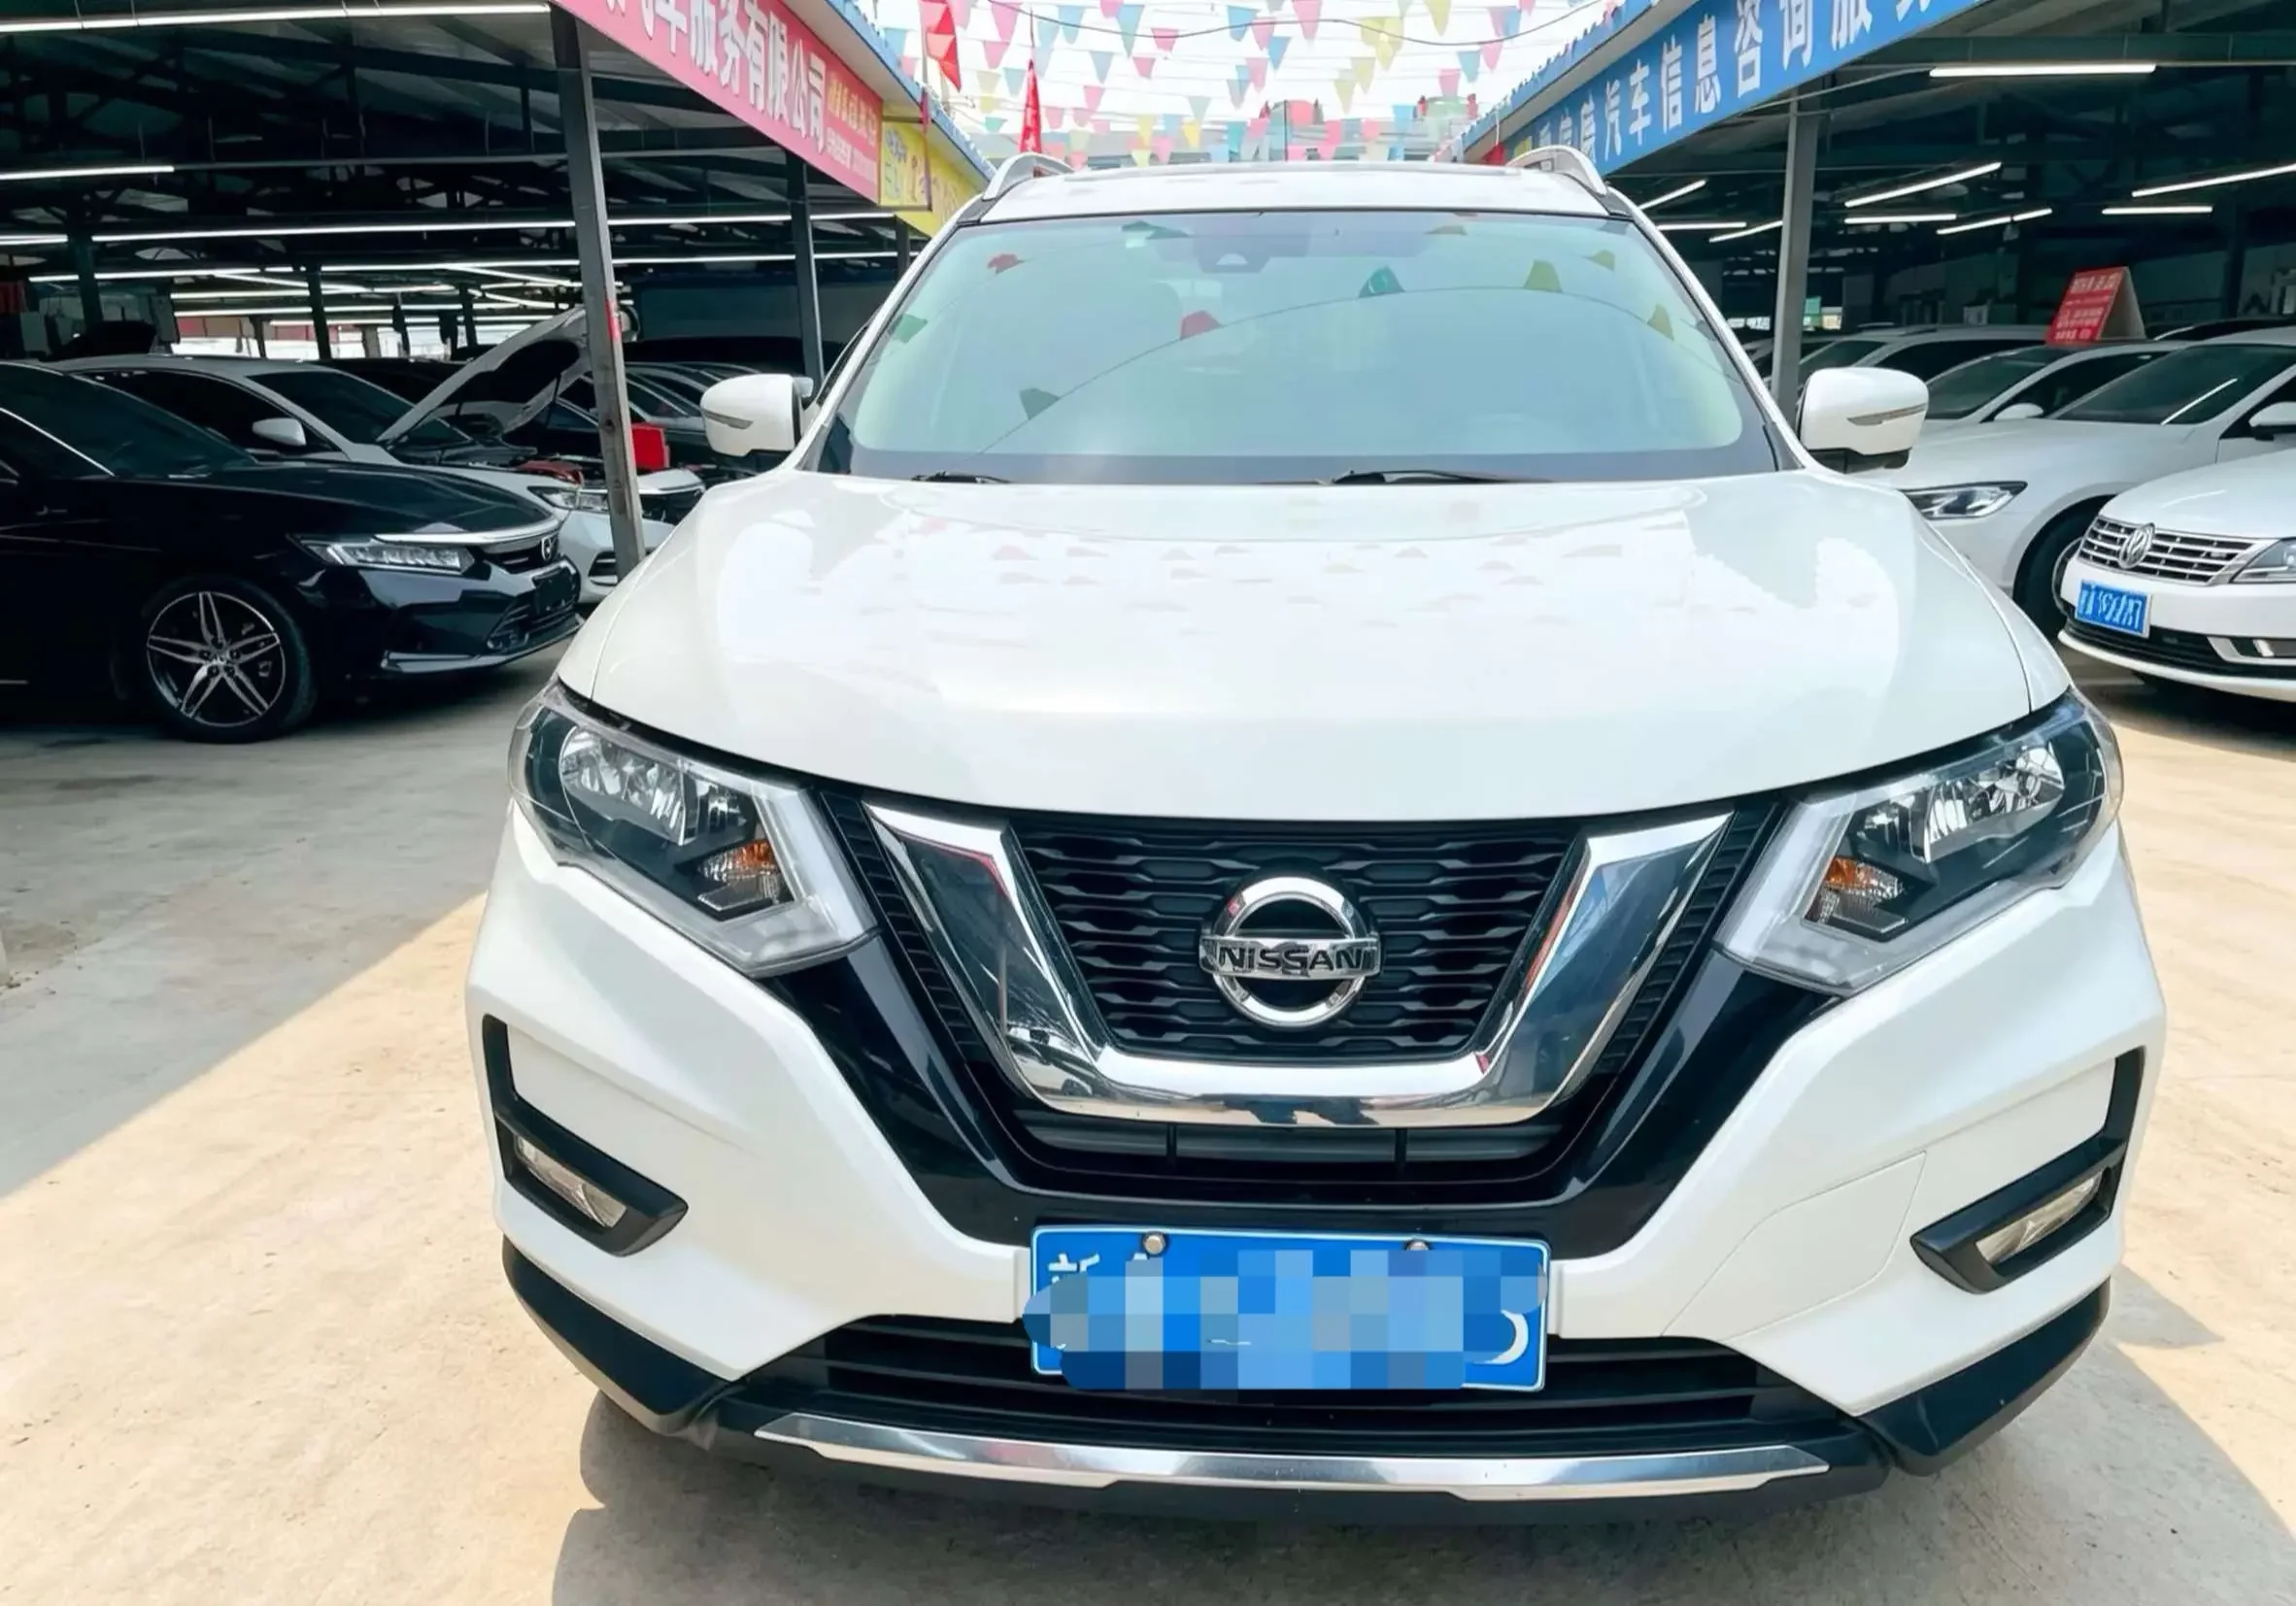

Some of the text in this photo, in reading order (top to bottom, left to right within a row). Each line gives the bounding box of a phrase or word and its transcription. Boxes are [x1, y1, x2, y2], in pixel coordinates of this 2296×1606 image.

[606, 0, 826, 154] 服务有限公司
[1539, 0, 1931, 163] 汽车信息咨询
[1217, 945, 1362, 976] NISSAN
